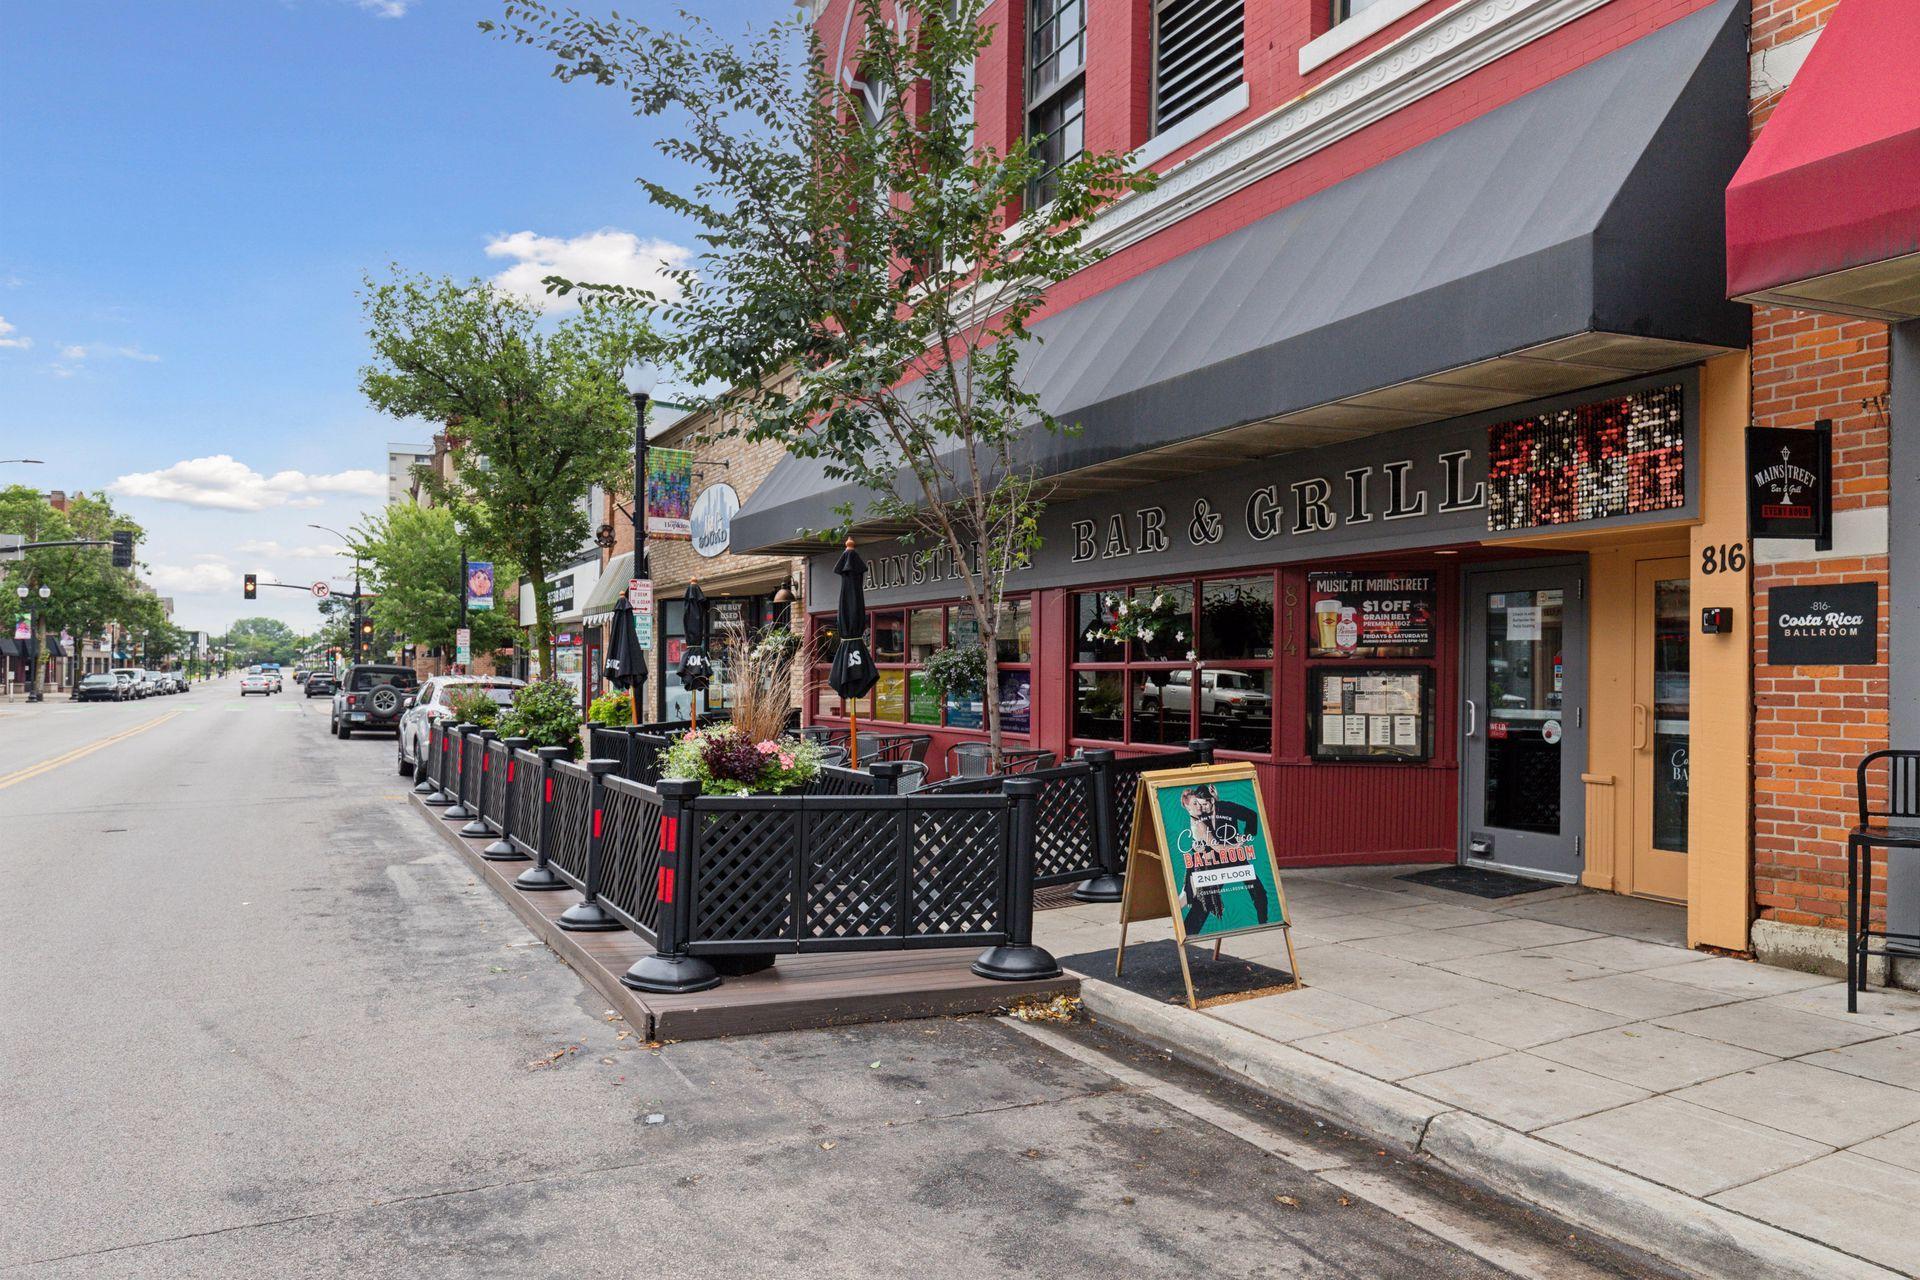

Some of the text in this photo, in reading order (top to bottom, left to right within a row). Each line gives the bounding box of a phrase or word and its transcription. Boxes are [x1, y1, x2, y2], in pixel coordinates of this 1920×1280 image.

[1754, 464, 1817, 488] MAINSTREET
[1770, 484, 1782, 493] Bar
[1788, 484, 1802, 495] Grill
[1071, 506, 1170, 563] BAR
[1188, 498, 1224, 546] &
[1245, 449, 1488, 541] GRILL
[1701, 543, 1746, 576] 816
[1316, 577, 1429, 593] MUSIC AT MAINSTREET
[1362, 600, 1379, 613] $1
[1381, 600, 1411, 612] OFF
[1363, 613, 1390, 621] GRAIN
[1391, 613, 1411, 621] BELT
[1778, 612, 1864, 629] Costa Rica
[1784, 627, 1858, 637] BALLROOM
[1215, 823, 1255, 847] Rica
[1182, 845, 1256, 869] BALLROOM
[1197, 870, 1251, 883] 2ND FLOOR
